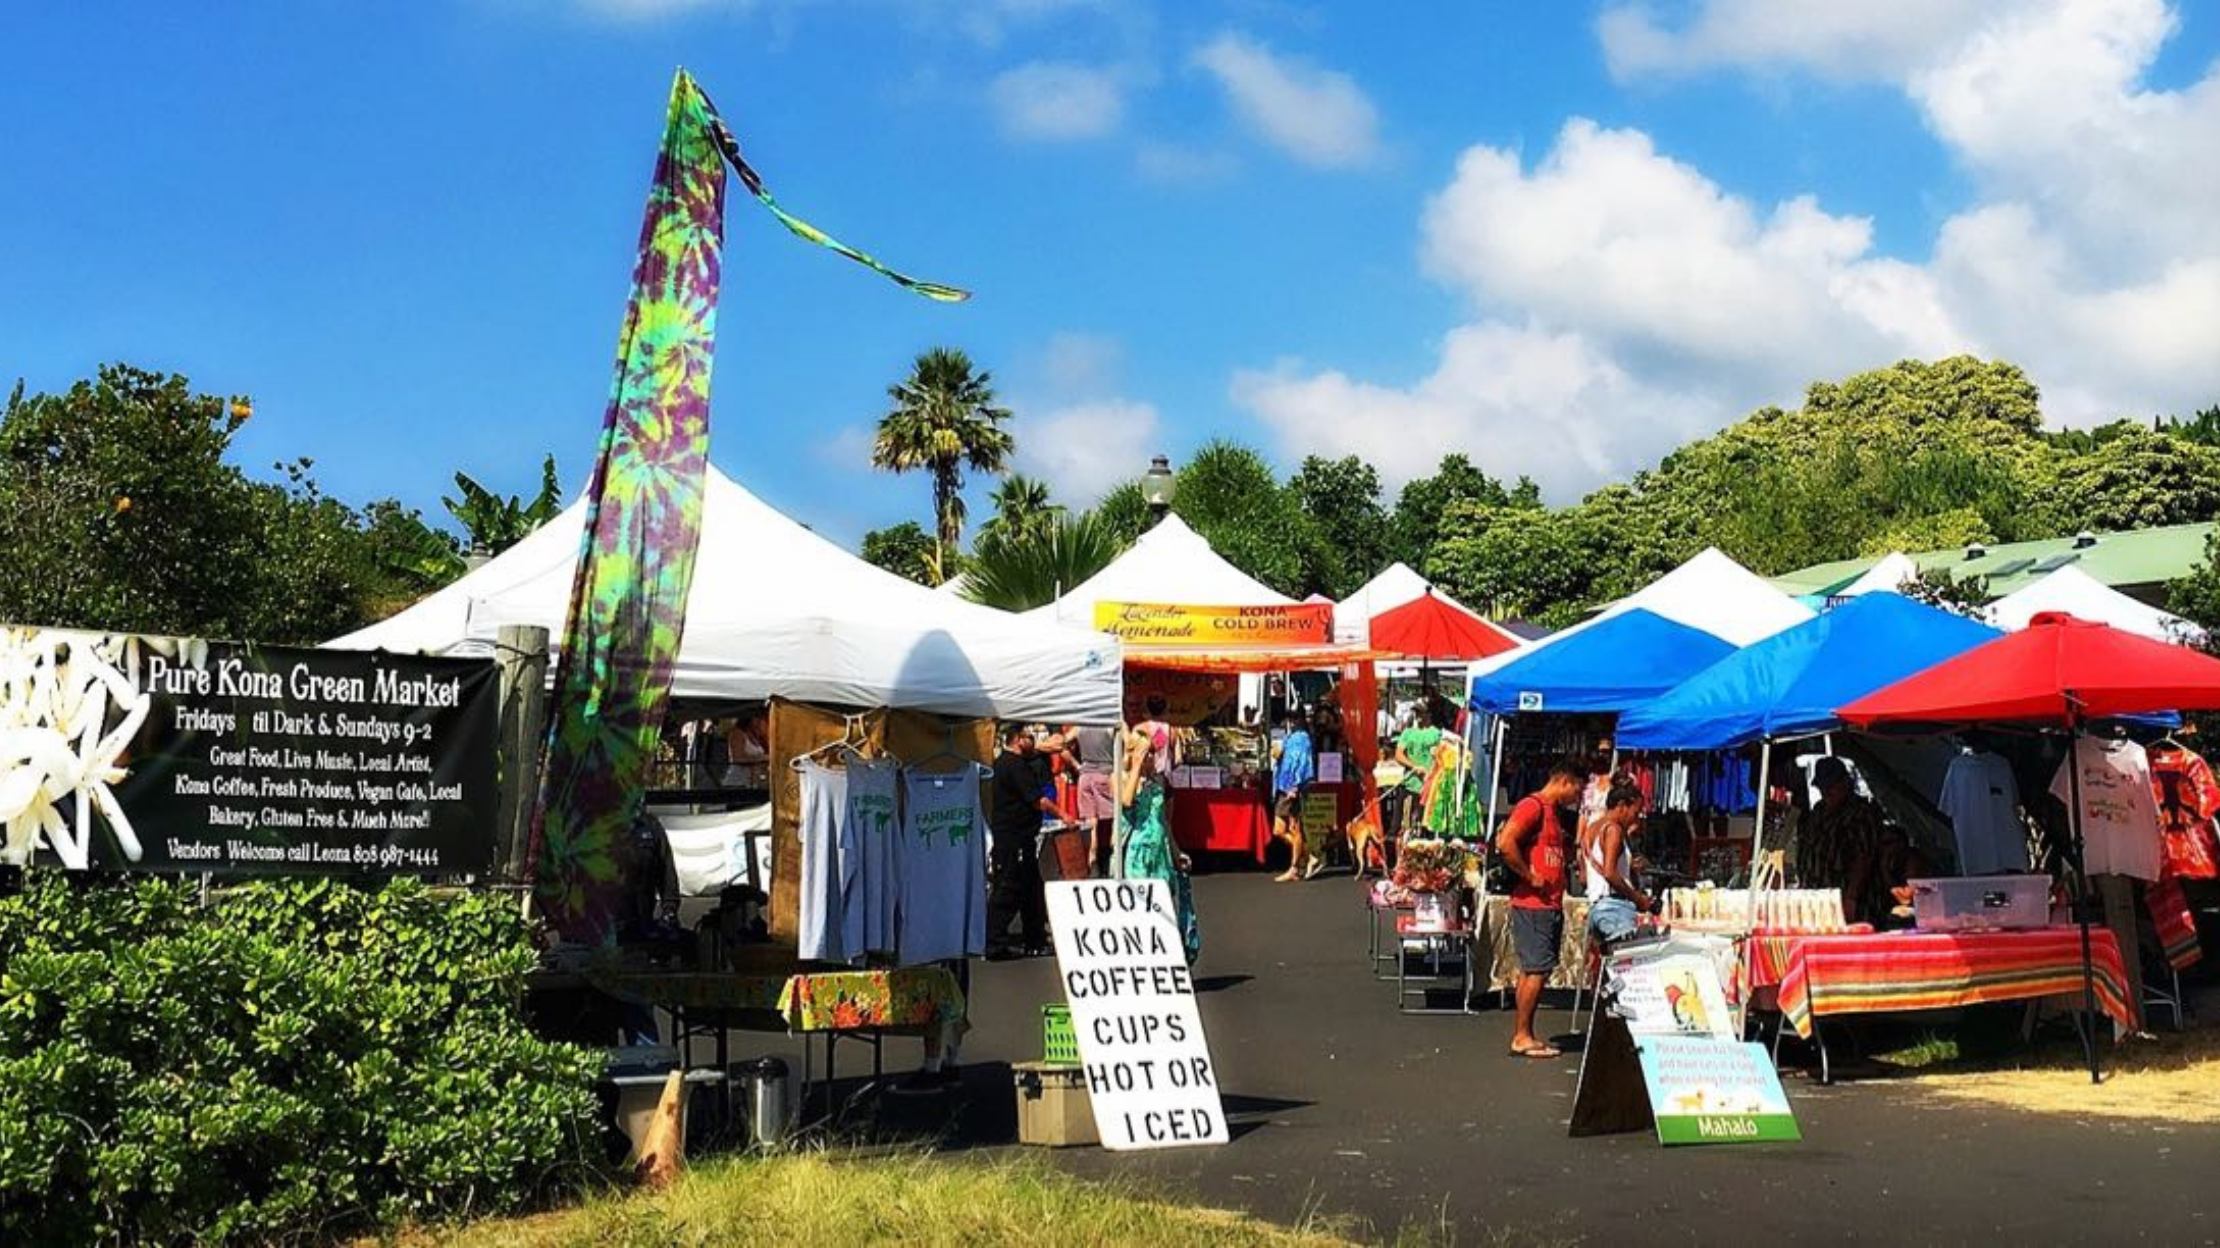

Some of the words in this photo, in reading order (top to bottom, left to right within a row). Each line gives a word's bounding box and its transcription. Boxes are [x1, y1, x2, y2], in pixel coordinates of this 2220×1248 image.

[1213, 617, 1259, 629] COLD
[1265, 618, 1313, 629] BREW
[1239, 606, 1287, 617] KONA
[147, 656, 211, 695] Pure
[216, 658, 283, 698] Kona
[290, 662, 365, 702] Green
[371, 668, 460, 707] Market
[175, 705, 236, 737] Fridays
[253, 711, 269, 733] til
[273, 709, 314, 735] Dark
[318, 712, 332, 735] &
[336, 712, 400, 745] Sundays
[404, 723, 432, 746] 9-2
[210, 746, 246, 766] Great
[284, 748, 311, 769] Live
[314, 750, 357, 772] Music,
[359, 752, 392, 772] Local
[175, 773, 210, 794] Kona
[213, 774, 259, 798] Coffee,
[261, 776, 297, 797] Fresh
[301, 778, 355, 801] Produce,
[357, 780, 393, 805] Vegan
[396, 781, 428, 802] Cafe,
[429, 781, 462, 800] Local
[208, 805, 259, 830] Bakery,
[261, 807, 303, 827] Gluten
[306, 807, 335, 827] Free
[337, 809, 348, 828] &
[351, 809, 387, 829] Much
[915, 807, 974, 823] FARMERS
[167, 837, 222, 860] Vendors
[227, 840, 285, 860] Welcome
[288, 842, 310, 861] call
[312, 842, 351, 862] Leona
[353, 844, 378, 863] 808
[380, 844, 439, 868] 987-1444
[1072, 883, 1162, 915] 100%
[1073, 926, 1167, 957] KONA
[1067, 966, 1192, 998] COFFEE
[1093, 1013, 1186, 1045] CUPS
[1087, 1061, 1154, 1094] HOT
[1168, 1057, 1211, 1088] OR
[1123, 1108, 1213, 1142] ICED
[1697, 1116, 1758, 1137] Mahalo
